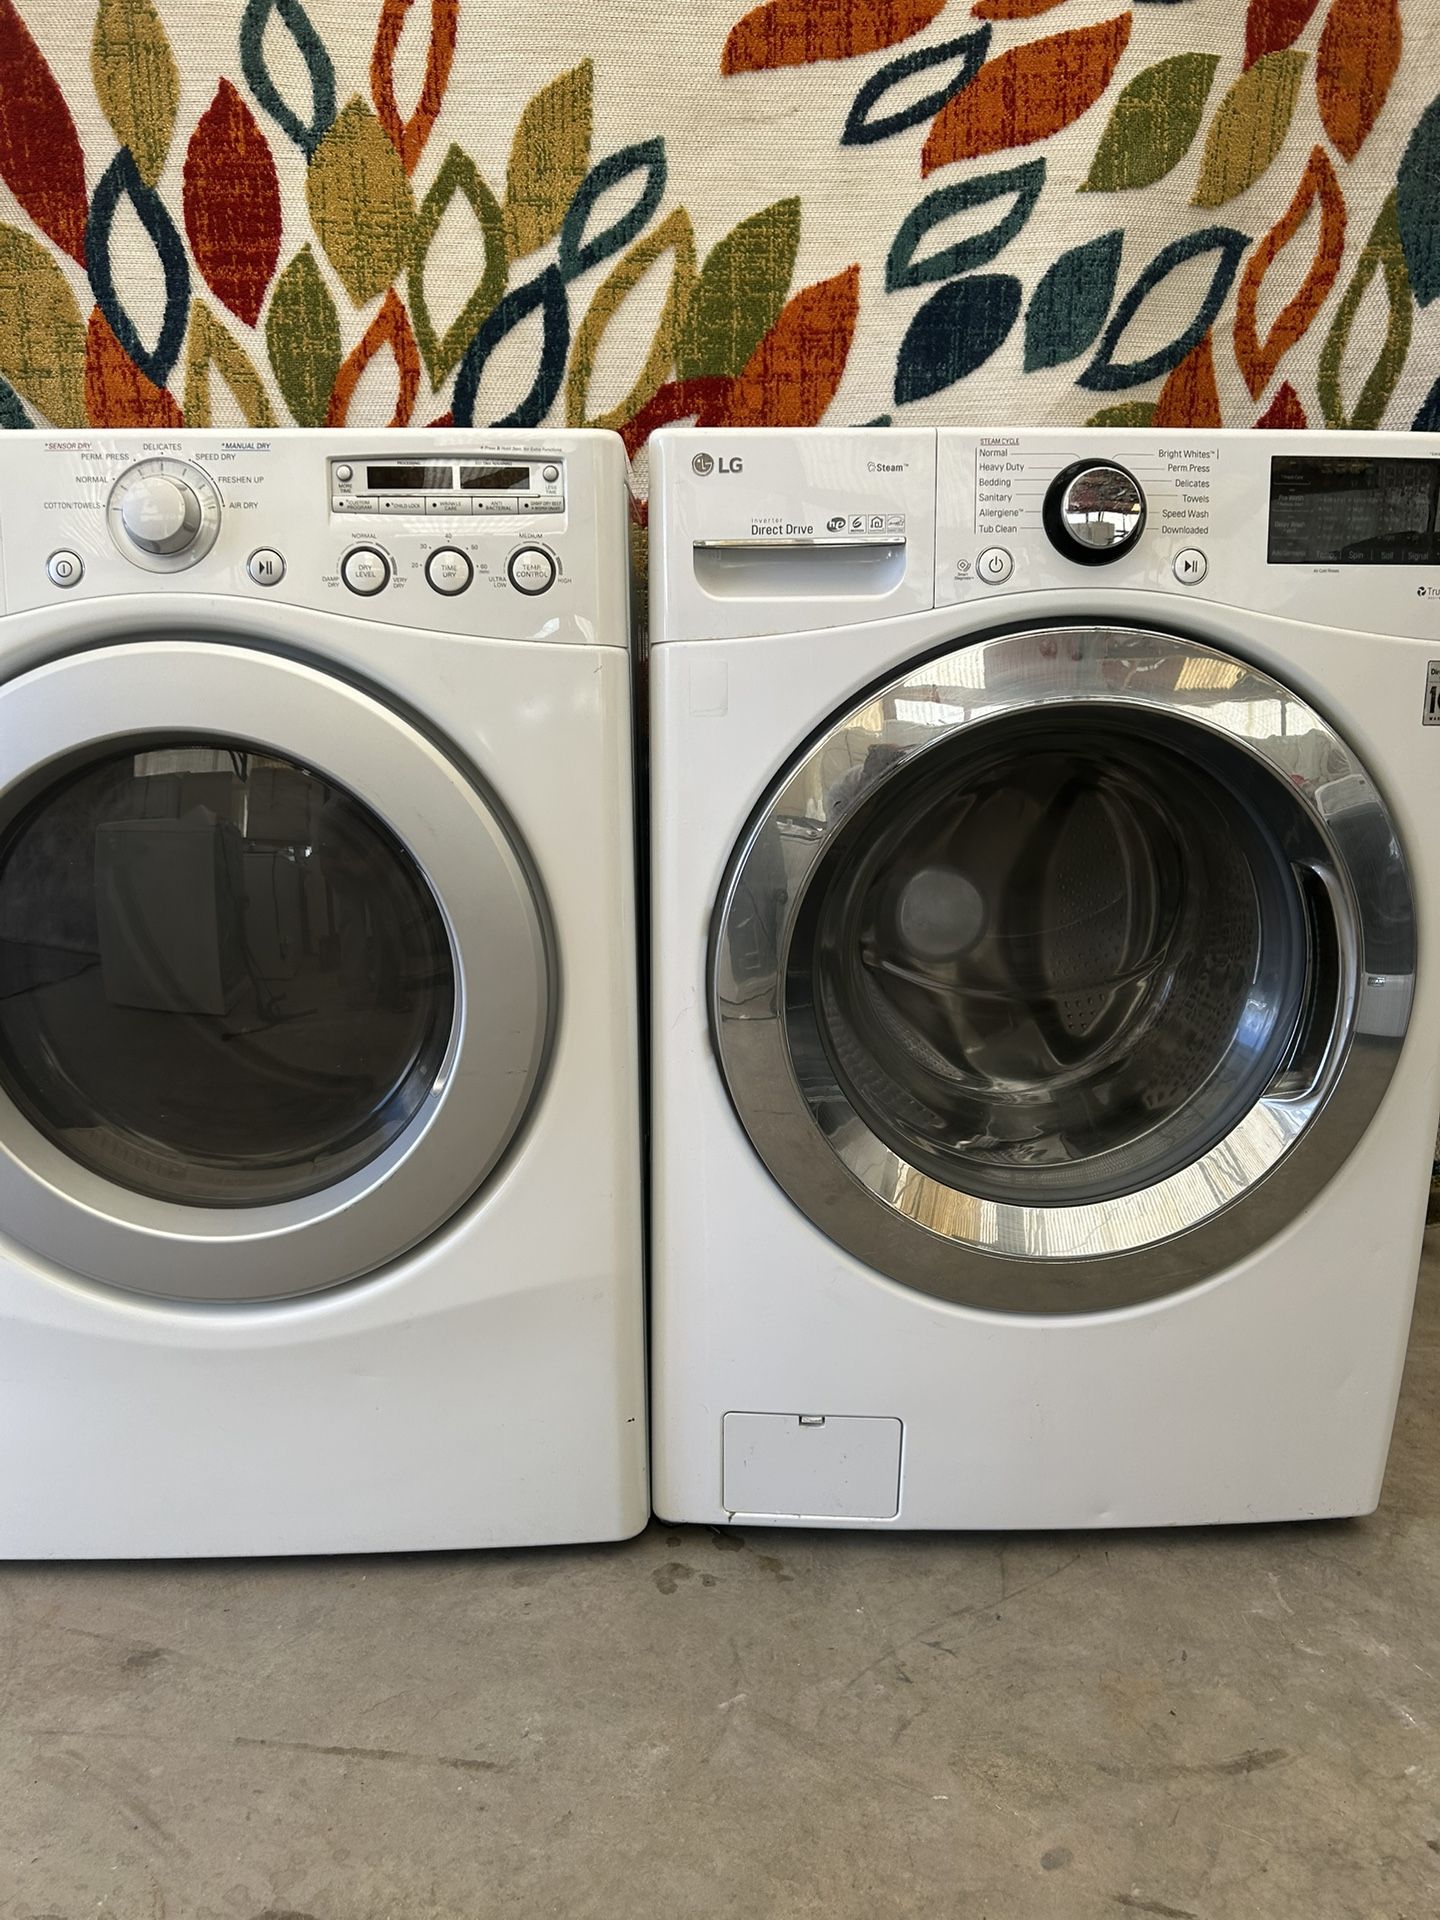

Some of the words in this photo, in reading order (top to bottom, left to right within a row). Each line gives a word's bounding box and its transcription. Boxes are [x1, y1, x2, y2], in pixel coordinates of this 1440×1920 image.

[77, 442, 92, 450] DRY
[143, 443, 183, 451] DELICATES
[980, 438, 1001, 446] STEAM
[1002, 438, 1020, 446] CYCLE
[195, 453, 220, 461] SPEED
[221, 453, 236, 461] DRY
[979, 448, 1008, 457] Normal
[1158, 449, 1182, 460] Bright
[718, 456, 743, 474] LG
[979, 462, 1004, 472] Heavy
[1006, 462, 1025, 472] Duty
[1168, 463, 1187, 472] Perm
[1189, 463, 1210, 473] Press
[218, 476, 252, 484] FRESHEN
[253, 476, 264, 484] UP
[979, 478, 1011, 488] Bedding
[1175, 479, 1210, 488] Delicates
[979, 493, 1013, 503] Sanitary
[1182, 494, 1210, 503] Towels
[1162, 509, 1186, 519] Speed
[1187, 509, 1209, 518] Wash
[751, 523, 783, 535] Direct
[785, 523, 814, 535] Drive
[979, 524, 994, 533] Tub
[995, 524, 1018, 533] Clean
[1161, 525, 1209, 535] Downloaded
[1349, 550, 1364, 561] Spin
[1381, 551, 1393, 560] Soil
[1408, 551, 1429, 561] Signal
